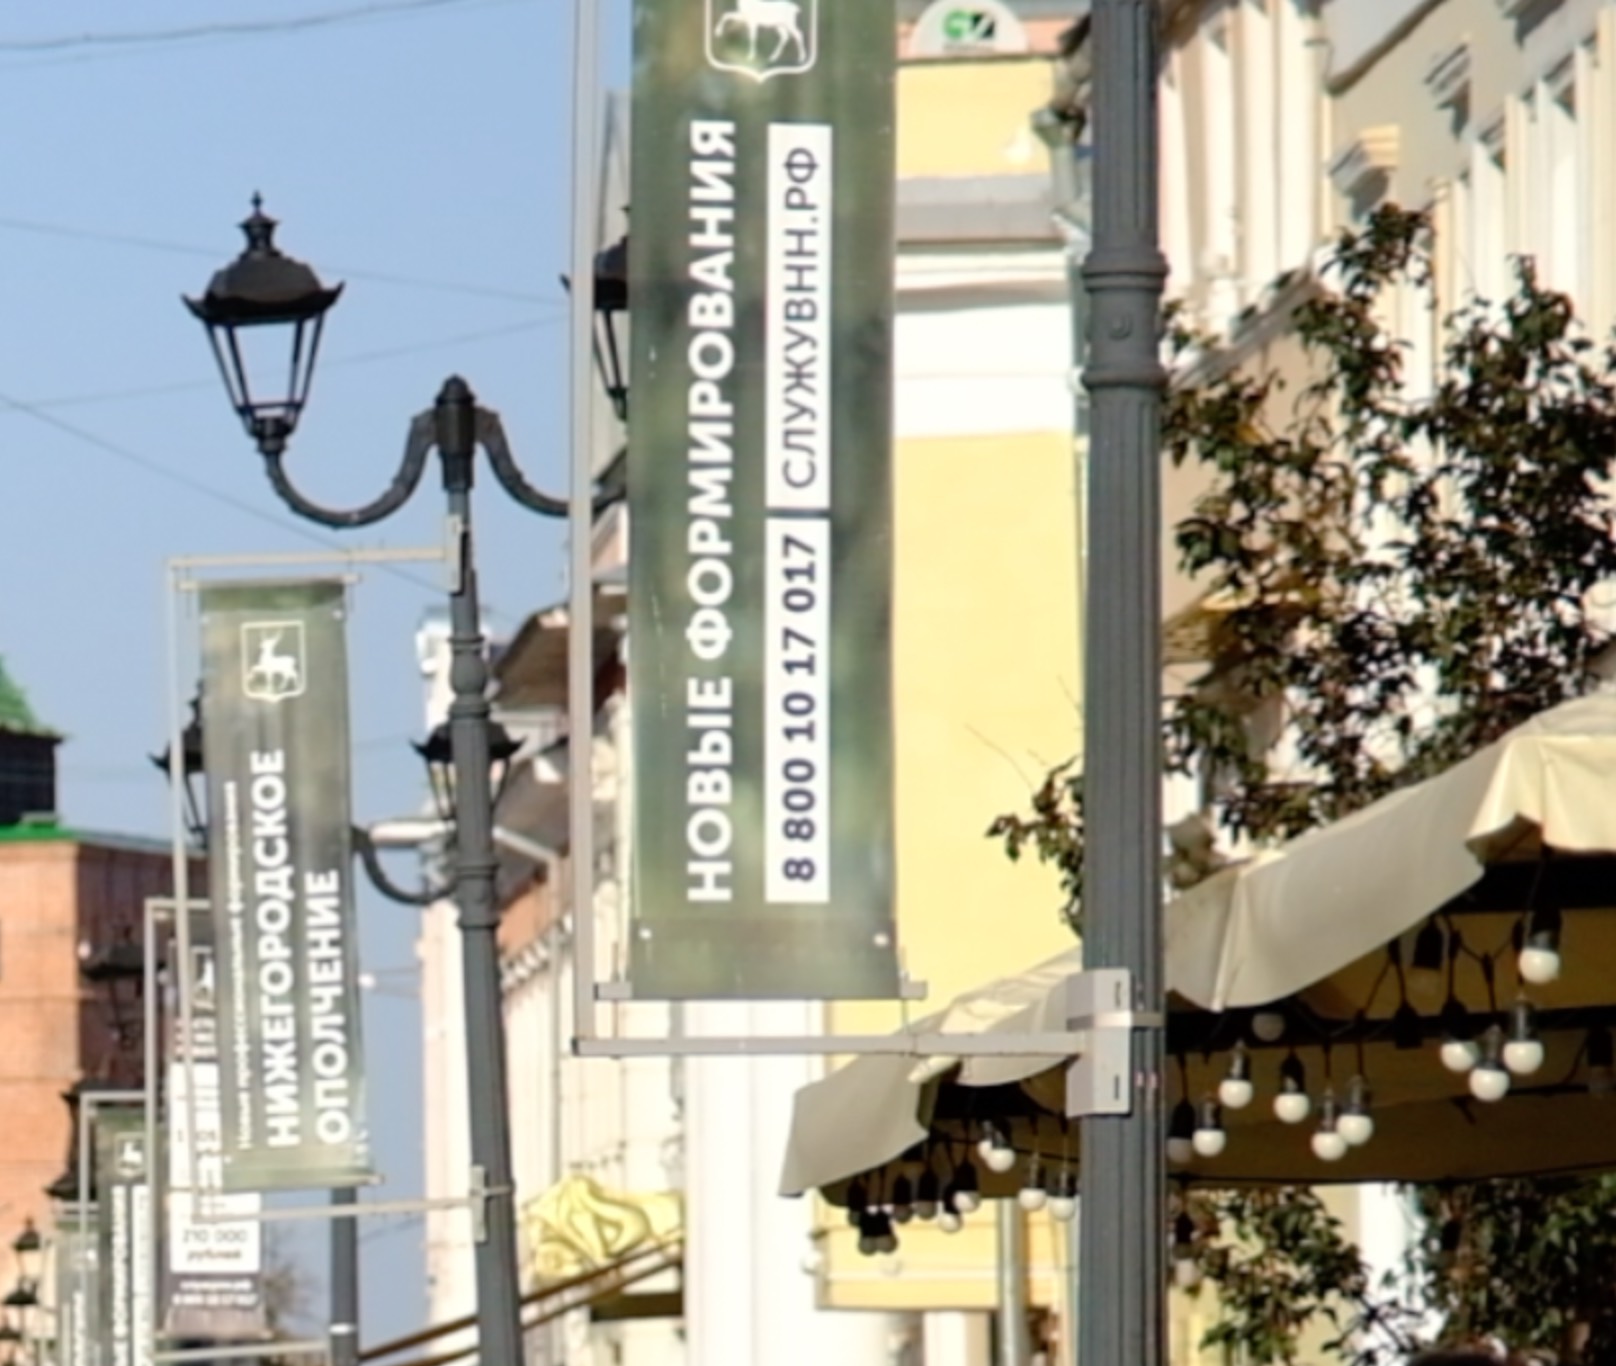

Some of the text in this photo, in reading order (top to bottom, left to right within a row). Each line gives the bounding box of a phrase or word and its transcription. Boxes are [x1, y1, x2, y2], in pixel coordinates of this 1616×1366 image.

[781, 146, 819, 490] СЛУЖУВНН.РФ
[684, 119, 736, 902] НОВЫЕ ФОРМИРОВАНИЯ
[781, 534, 817, 883] 8 800 10 17 017
[249, 748, 300, 1149] НИЖЕГОРОДСКОЕ
[303, 870, 350, 1147] ОПОЛЧЕНИЕ
